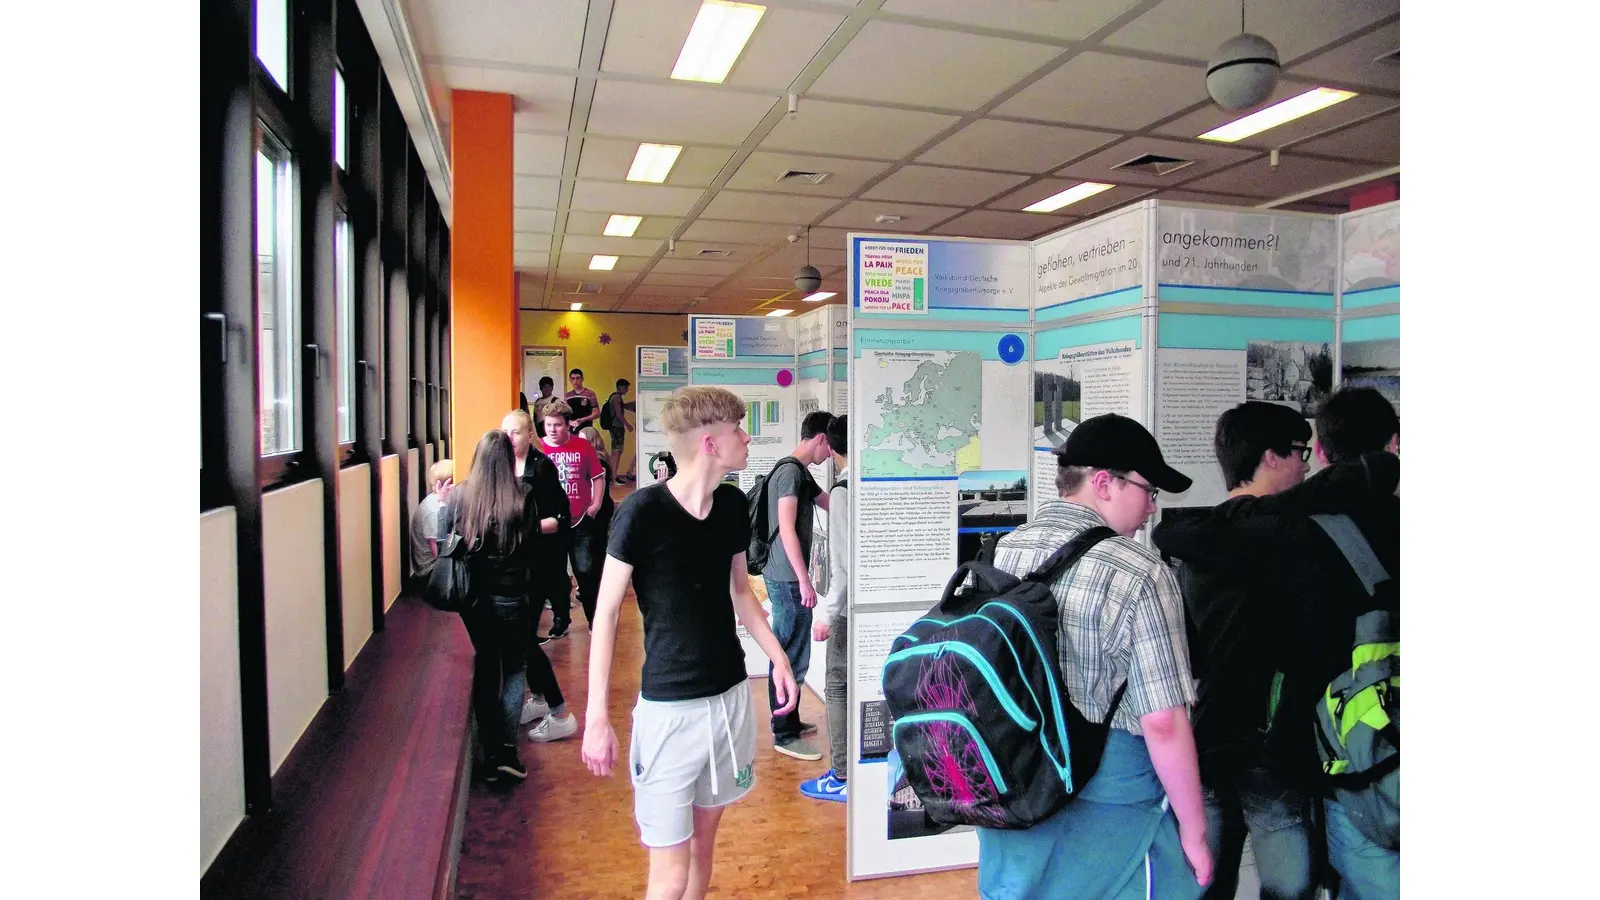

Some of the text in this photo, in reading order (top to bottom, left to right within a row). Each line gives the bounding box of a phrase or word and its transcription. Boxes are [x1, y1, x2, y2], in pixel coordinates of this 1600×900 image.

[1162, 228, 1280, 251] angekommen?!
[1037, 253, 1075, 279] geflohen,
[1078, 237, 1125, 262] vertrieben
[1162, 256, 1258, 272] und 21. Jahrhundert
[895, 267, 924, 275] PEACE
[934, 273, 998, 282] Volksbund Deutsche
[1037, 258, 1140, 294] Aspekte der Gewaltmigration im 20.
[864, 279, 893, 287] VREDE
